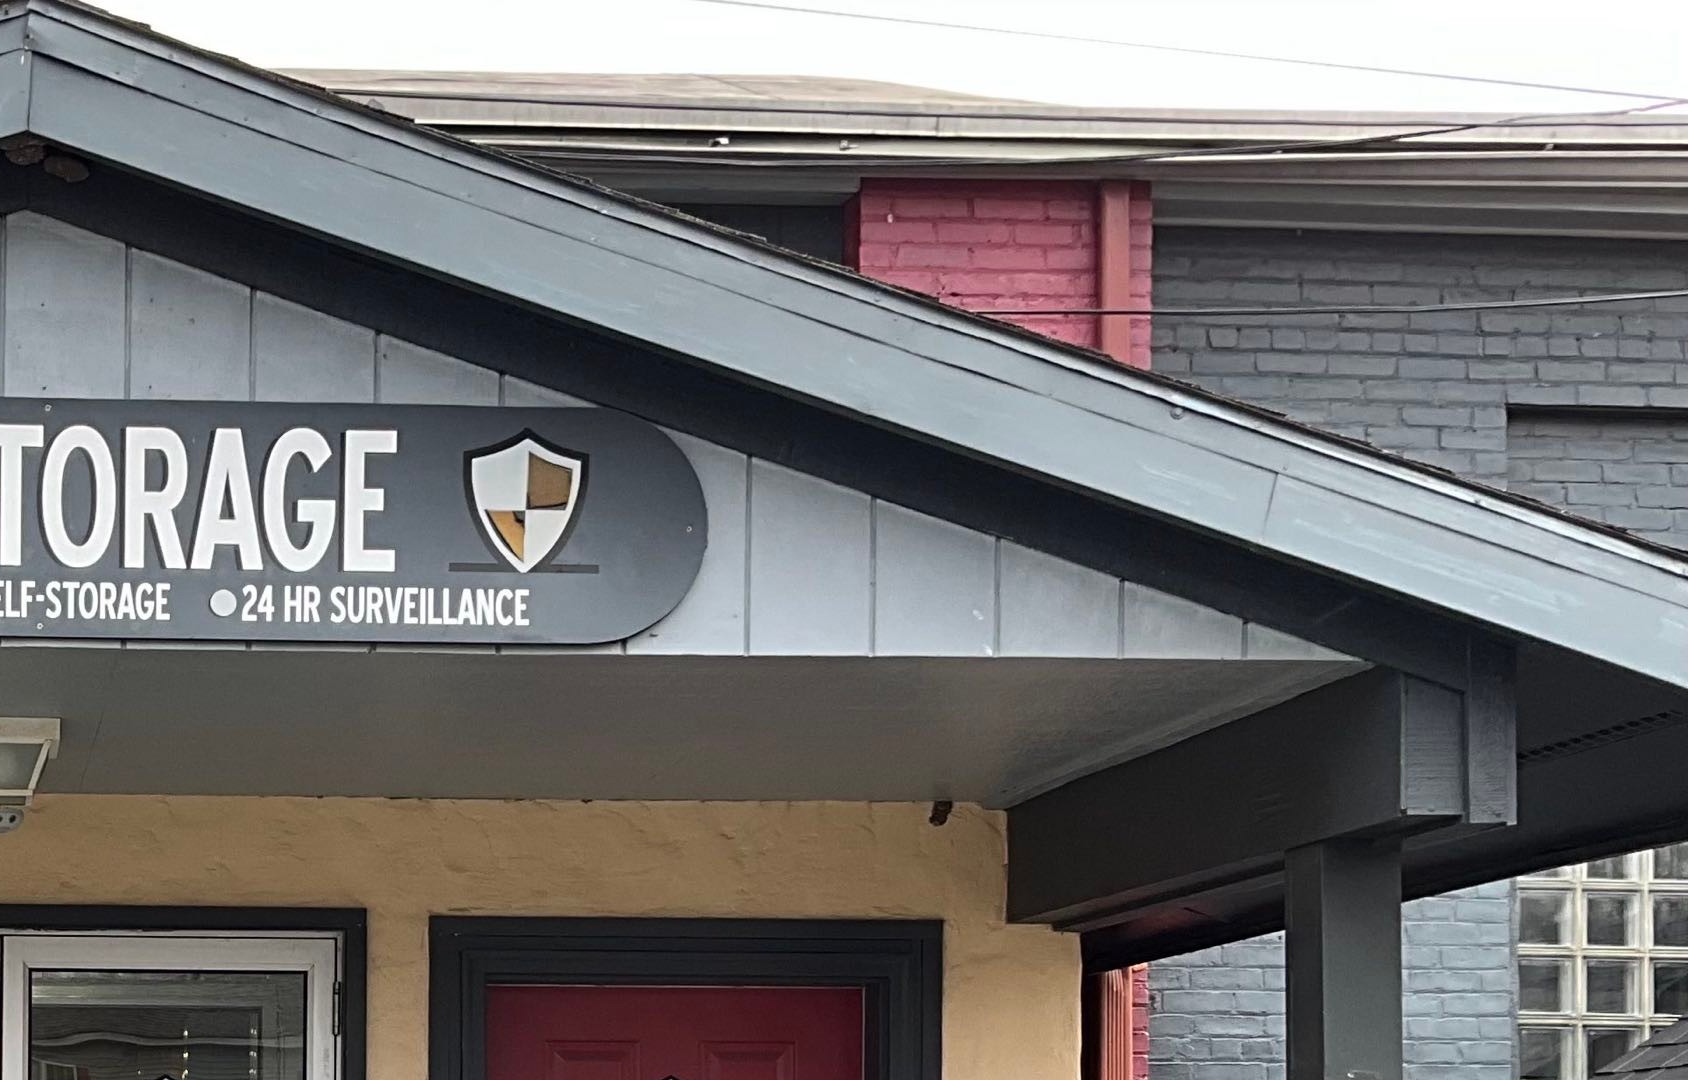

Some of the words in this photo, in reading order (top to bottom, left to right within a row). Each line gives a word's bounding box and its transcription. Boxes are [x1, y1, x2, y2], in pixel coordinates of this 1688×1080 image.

[241, 586, 274, 620] 24
[283, 588, 322, 622] HR
[330, 587, 530, 626] SURVEILLANCE
